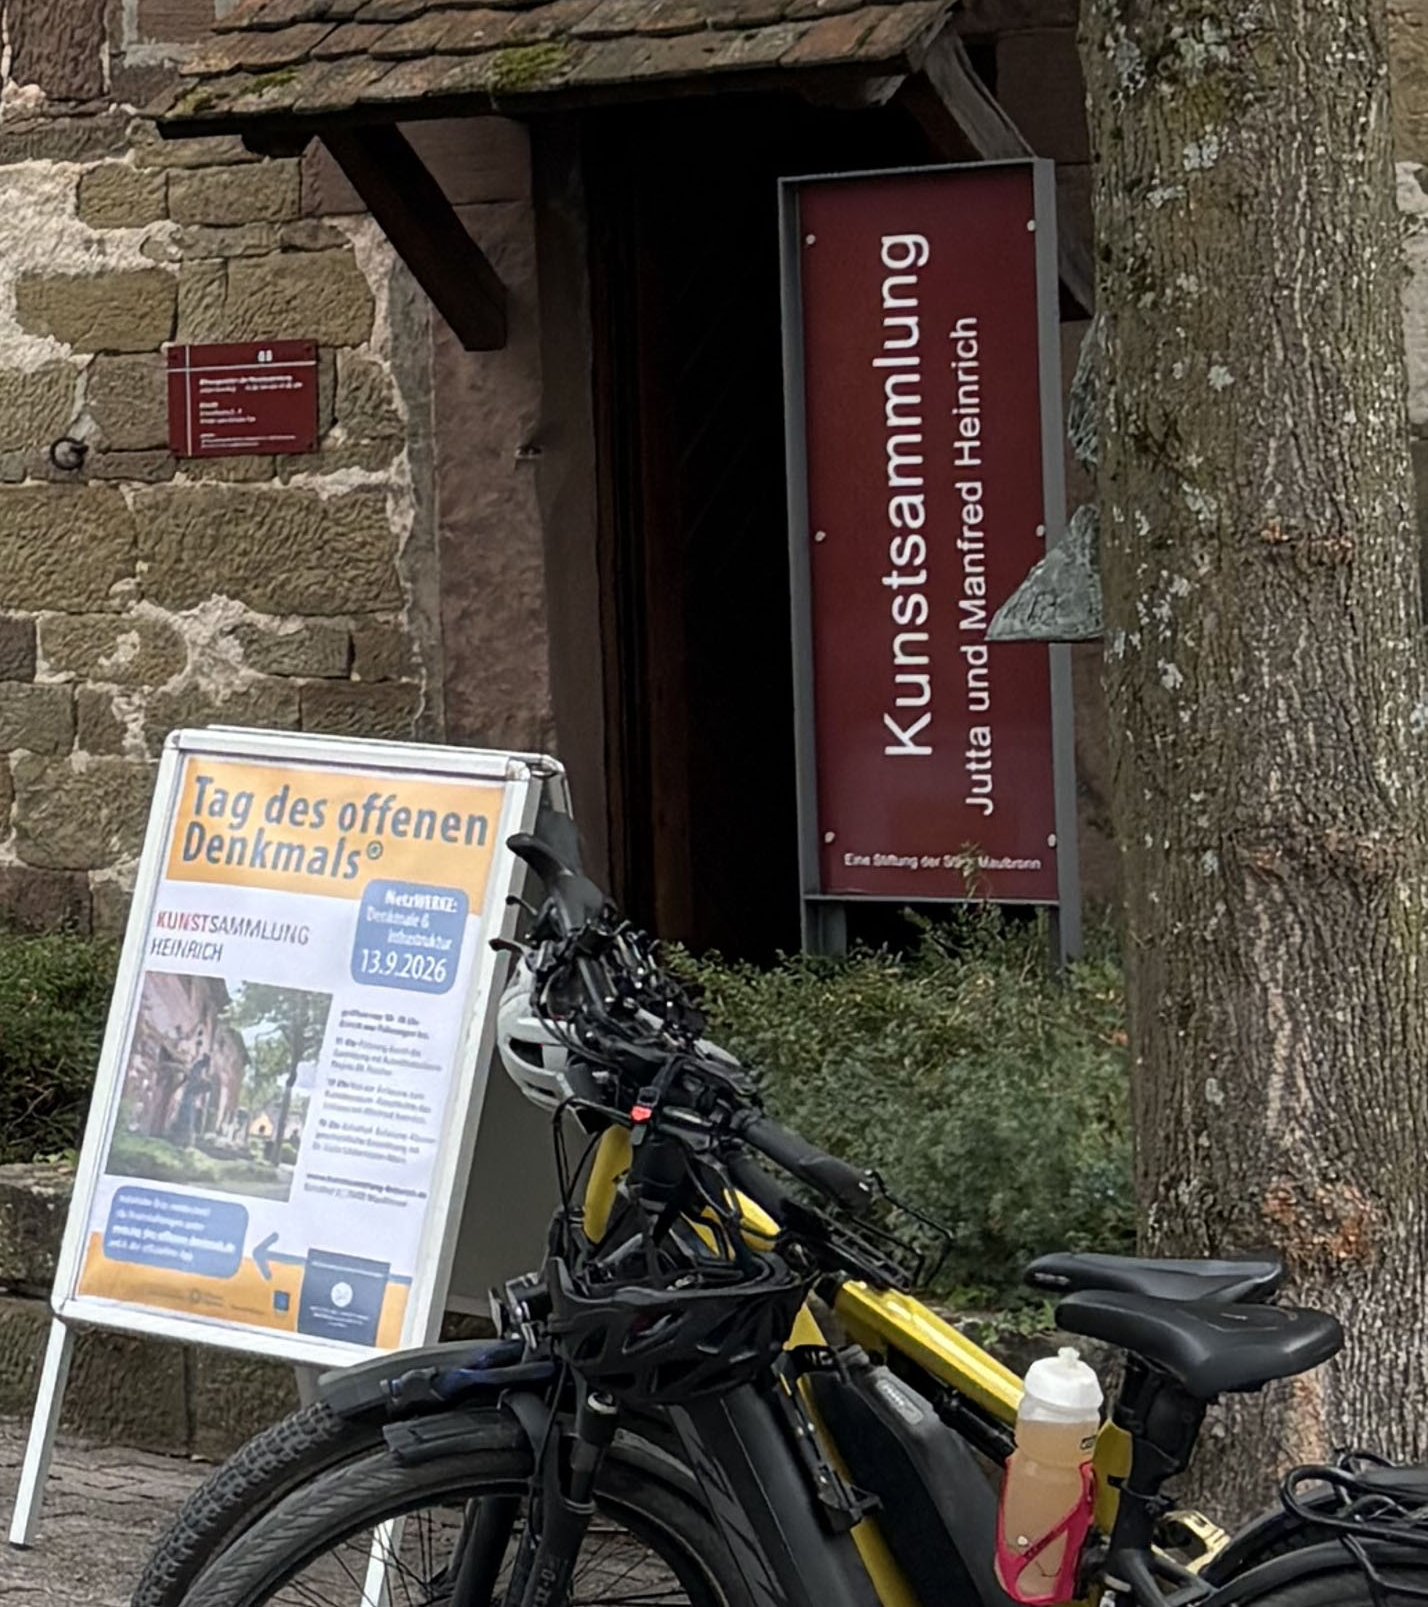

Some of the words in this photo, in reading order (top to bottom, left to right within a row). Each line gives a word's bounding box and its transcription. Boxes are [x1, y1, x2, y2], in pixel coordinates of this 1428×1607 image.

[949, 317, 982, 467] Heinrich
[872, 234, 933, 756] Kunstsammlung
[954, 481, 987, 631] Manfred
[960, 645, 990, 712] und
[965, 726, 994, 817] Jutta
[194, 775, 254, 831] Tag
[264, 784, 328, 830] des
[338, 793, 490, 847] offenen
[844, 853, 871, 867] Eine
[872, 853, 918, 870] Stiftung
[920, 855, 941, 869] der
[977, 855, 1042, 870] Maulbronn
[150, 936, 224, 963] HEINRICH
[156, 909, 310, 946] KUNSTSAMMLUNG
[360, 948, 448, 984] 13.9.2026
